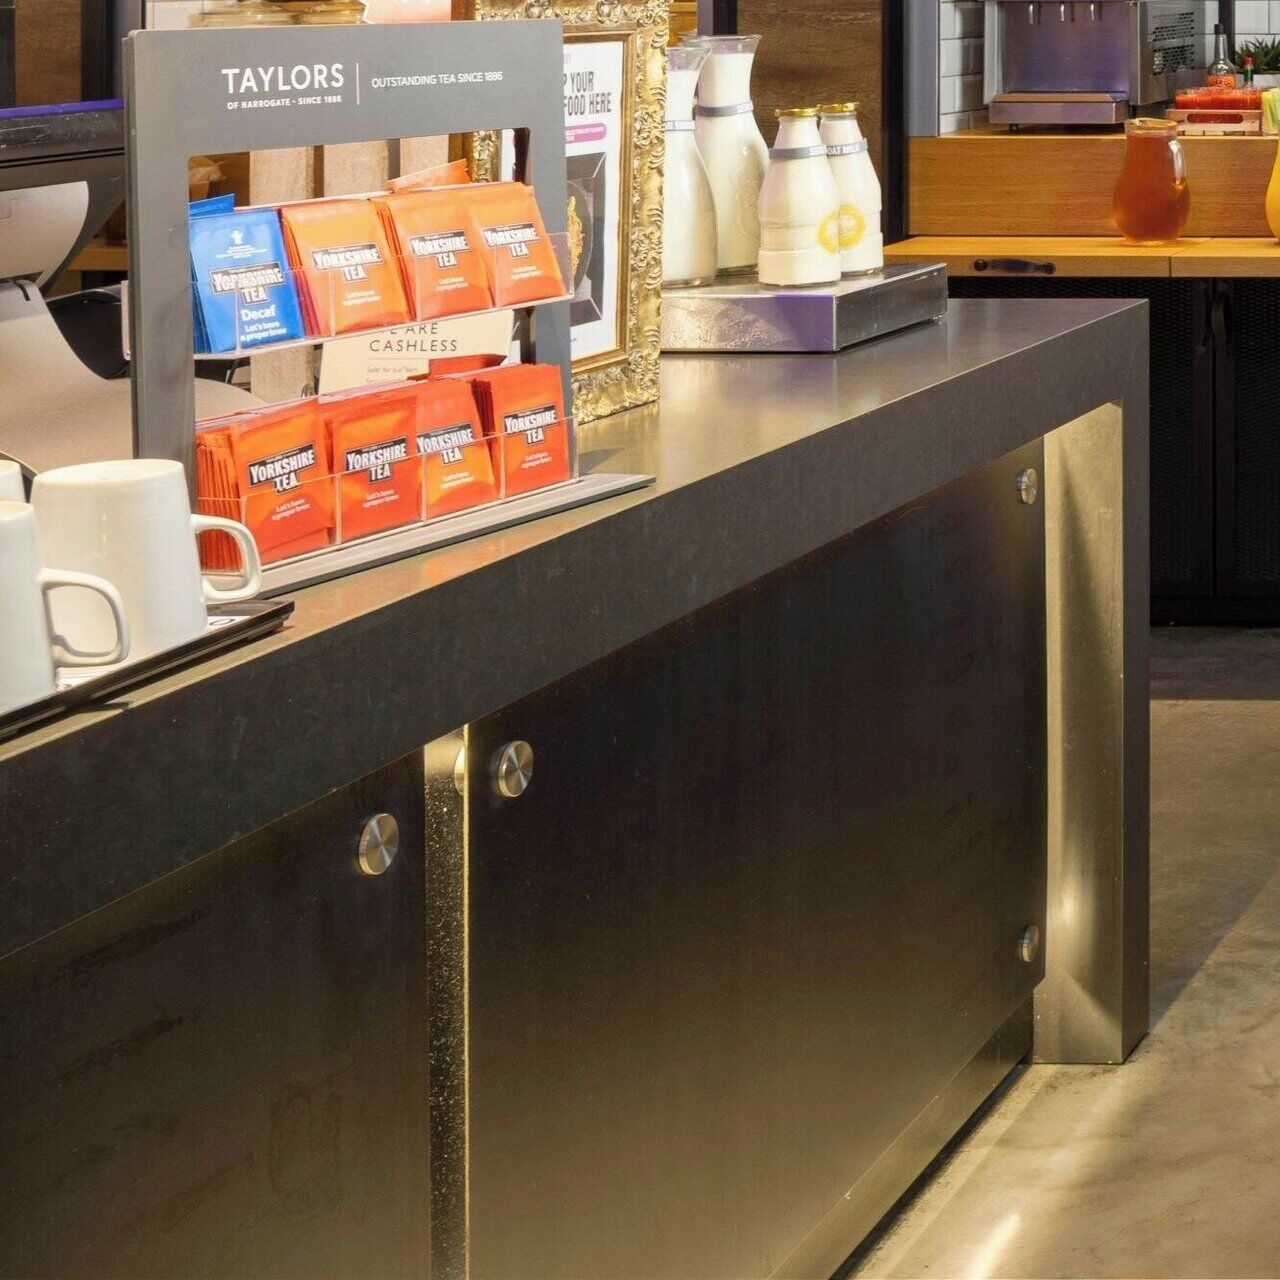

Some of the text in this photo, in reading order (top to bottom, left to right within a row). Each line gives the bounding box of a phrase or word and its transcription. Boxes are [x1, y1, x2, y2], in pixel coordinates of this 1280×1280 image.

[221, 63, 345, 94] TAYLORS
[371, 70, 504, 88] OUTSTANDING TEA SINCE 1886
[571, 71, 595, 92] YOUR
[227, 94, 342, 110] OF HARROGATE SINCE 1886
[588, 92, 612, 115] HERE
[410, 236, 468, 257] YORKSHIRE
[483, 227, 538, 248] YORKSHIRE
[312, 248, 381, 270] YORKSHIRE
[437, 252, 458, 268] TEA
[510, 243, 530, 257] TEA
[212, 268, 284, 293] YORKSHIRE
[343, 266, 367, 282] TEA
[243, 286, 267, 304] TEA
[241, 304, 276, 322] Decaf
[369, 339, 458, 352] CASHLESS
[504, 410, 557, 435] YORKSHIRE
[416, 428, 474, 454] YORKSHIRE
[526, 428, 545, 445] TEA
[250, 449, 315, 484] YORKSHIRE
[347, 443, 407, 471] YORKSHIRE
[441, 448, 463, 465] TEA
[274, 472, 299, 493] TEA
[370, 464, 391, 483] TEA
